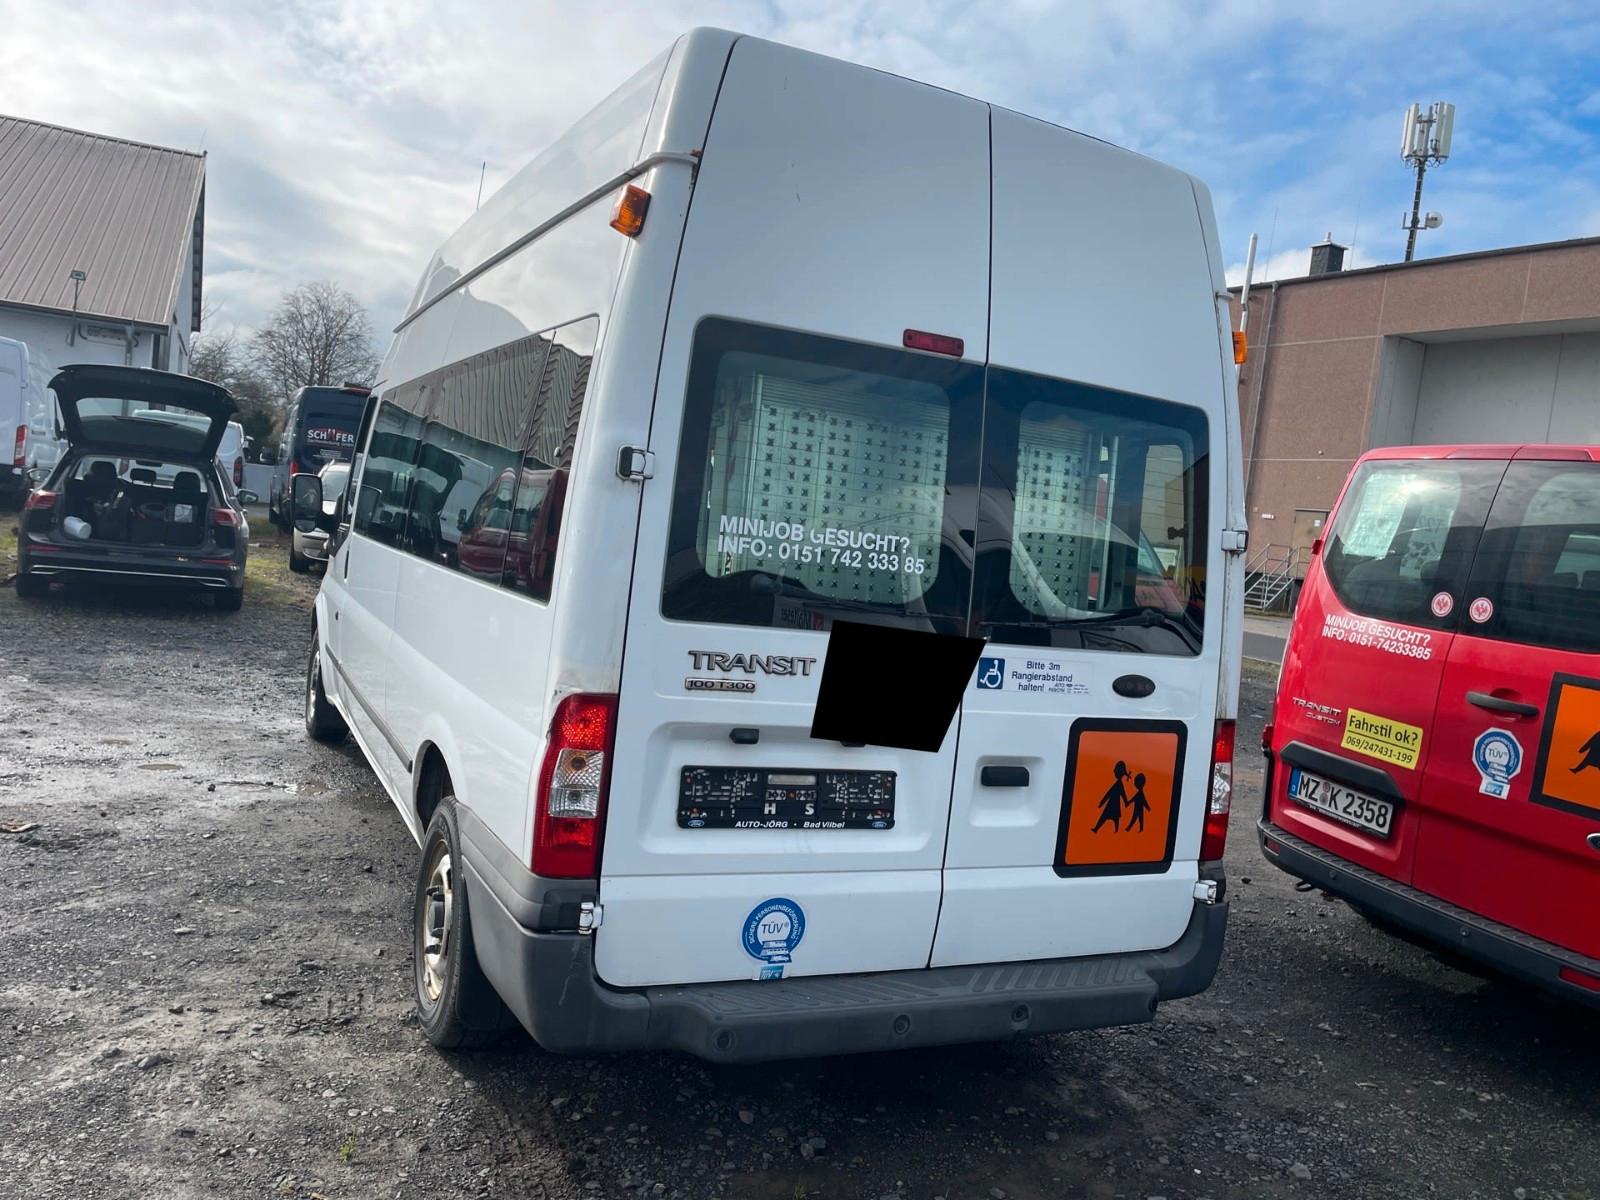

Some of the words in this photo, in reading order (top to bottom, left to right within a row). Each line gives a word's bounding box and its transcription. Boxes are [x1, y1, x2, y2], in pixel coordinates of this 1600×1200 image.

[720, 515, 804, 541] MINIJOB
[810, 528, 910, 553] GESUCHT?
[718, 534, 772, 557] INFO:
[778, 542, 822, 563] 0151
[831, 548, 862, 568] 742
[868, 552, 899, 571] 333
[904, 556, 925, 574] 85
[1322, 625, 1347, 642] INFO:
[1348, 631, 1432, 660] 0151-74233385
[1325, 614, 1367, 633] MINIJOB
[1368, 623, 1431, 646] GESUCHT?
[688, 650, 816, 676] TRANSIT
[1011, 670, 1073, 682] Rangierabstand
[1026, 660, 1045, 670] Bitte
[1048, 662, 1061, 671] 3m
[688, 680, 715, 688] 100
[719, 681, 756, 690] T300
[1018, 682, 1044, 692] halten!
[1292, 697, 1342, 716] TRANSIT
[1349, 715, 1392, 738] Fahrstil
[1394, 730, 1418, 746] ok?
[1346, 735, 1412, 763] 069/247431-199
[764, 803, 776, 814] H
[804, 803, 815, 815] S
[1299, 775, 1320, 802] MZ
[1328, 787, 1342, 811] K
[1342, 793, 1389, 828] 2358
[735, 820, 788, 828] AUTO-JÖRG
